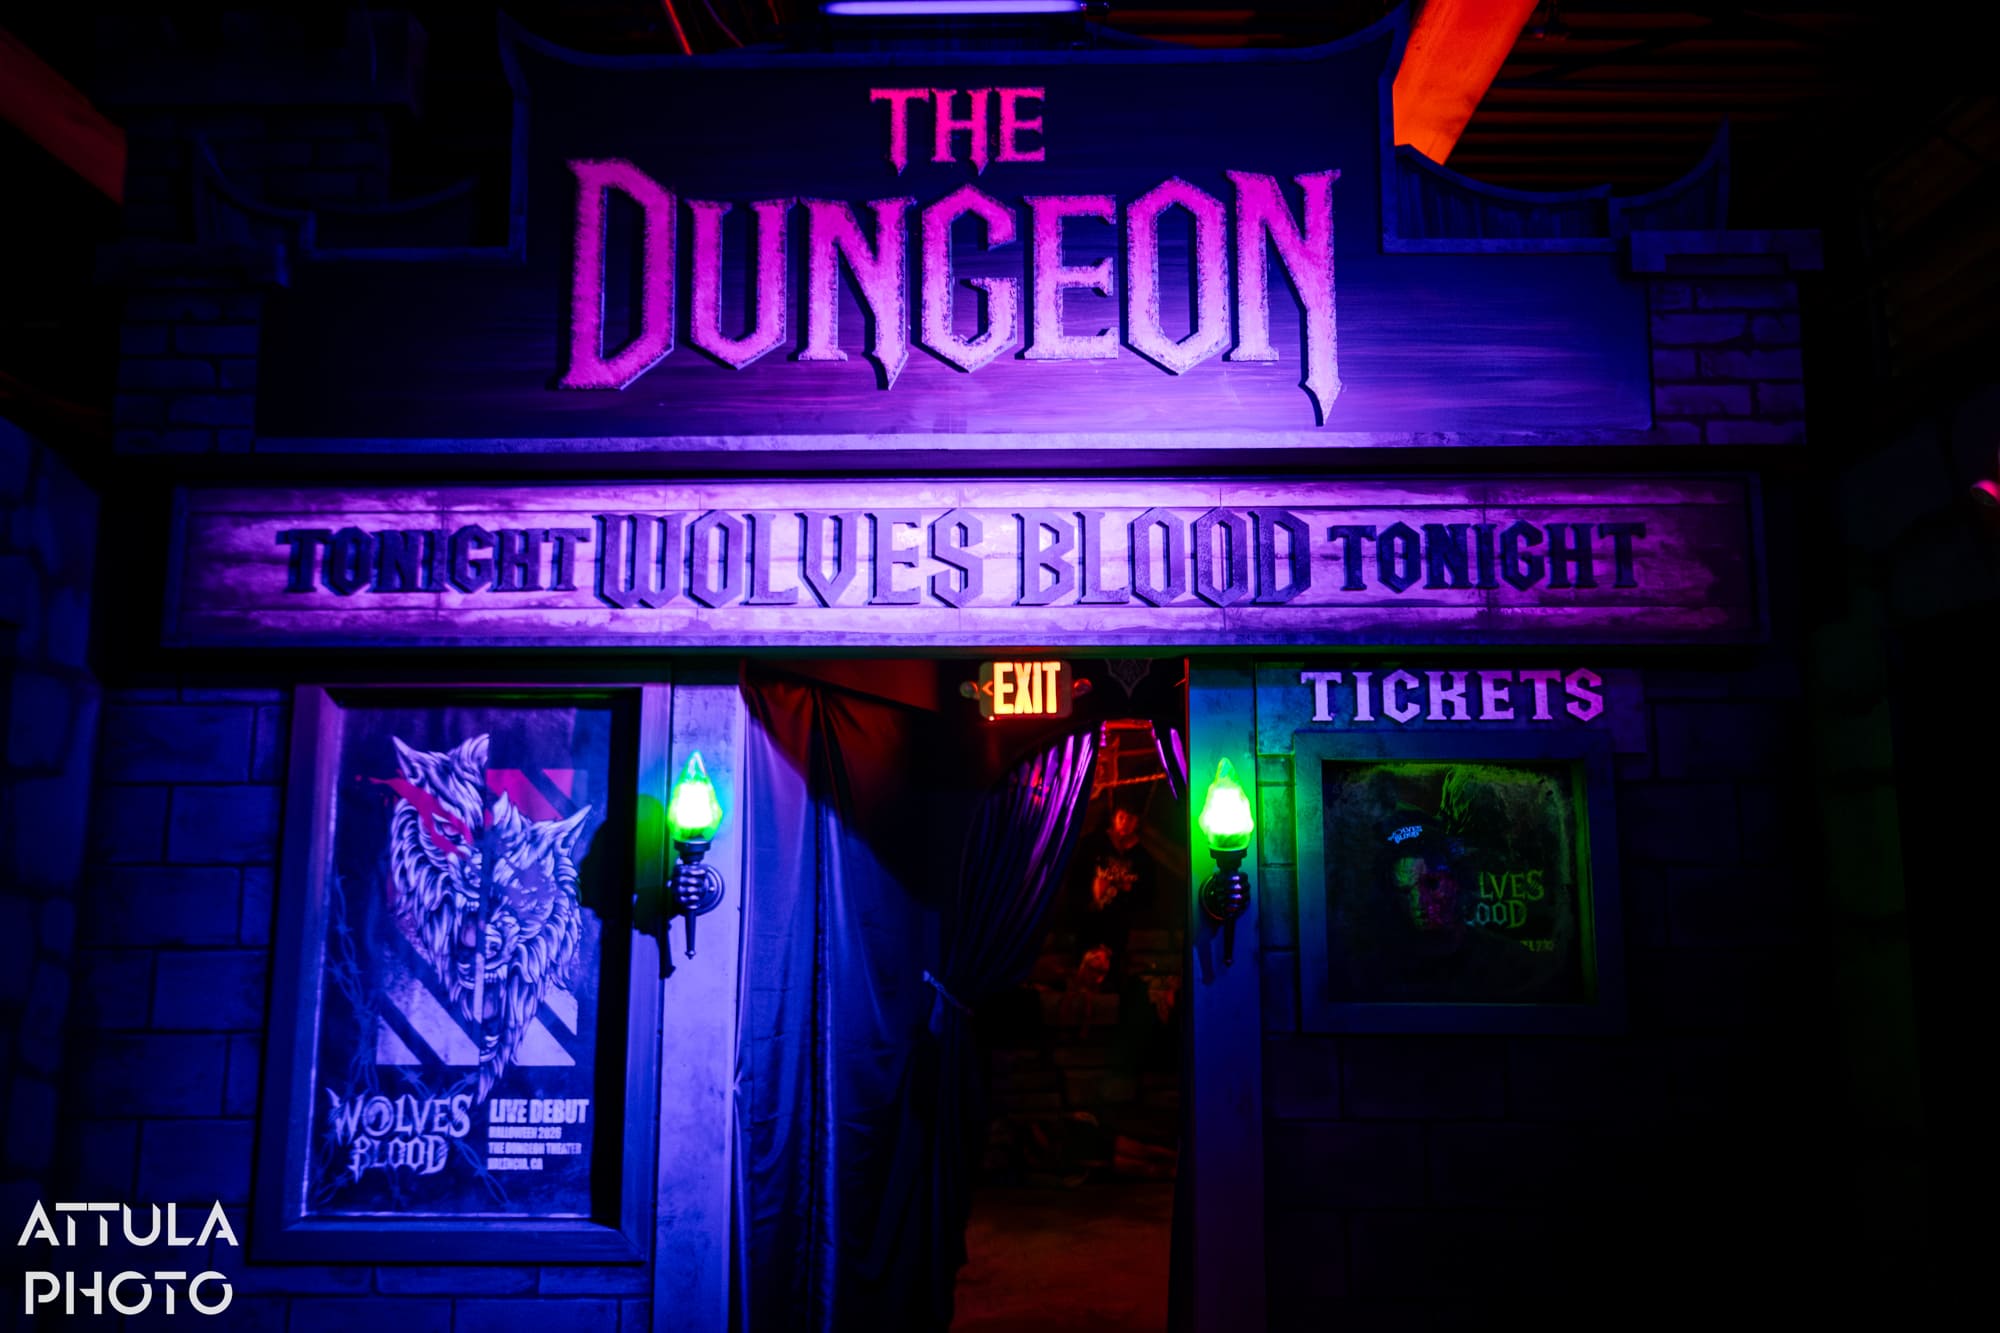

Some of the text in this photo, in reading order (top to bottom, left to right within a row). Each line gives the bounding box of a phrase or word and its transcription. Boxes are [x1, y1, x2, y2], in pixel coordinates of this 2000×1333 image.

[870, 86, 1046, 176] THE
[556, 157, 1342, 427] DUNGEON
[276, 507, 1647, 609] TONIGHT WOLVES BLOOD TONIGHT
[993, 661, 1062, 715] EXIT
[1300, 667, 1605, 725] TICKETS
[326, 1088, 474, 1146] WOLVES
[488, 1098, 590, 1124] LIVE DEBUT
[488, 1126, 537, 1139] HALLOWEEN
[349, 1135, 450, 1183] BLOOD
